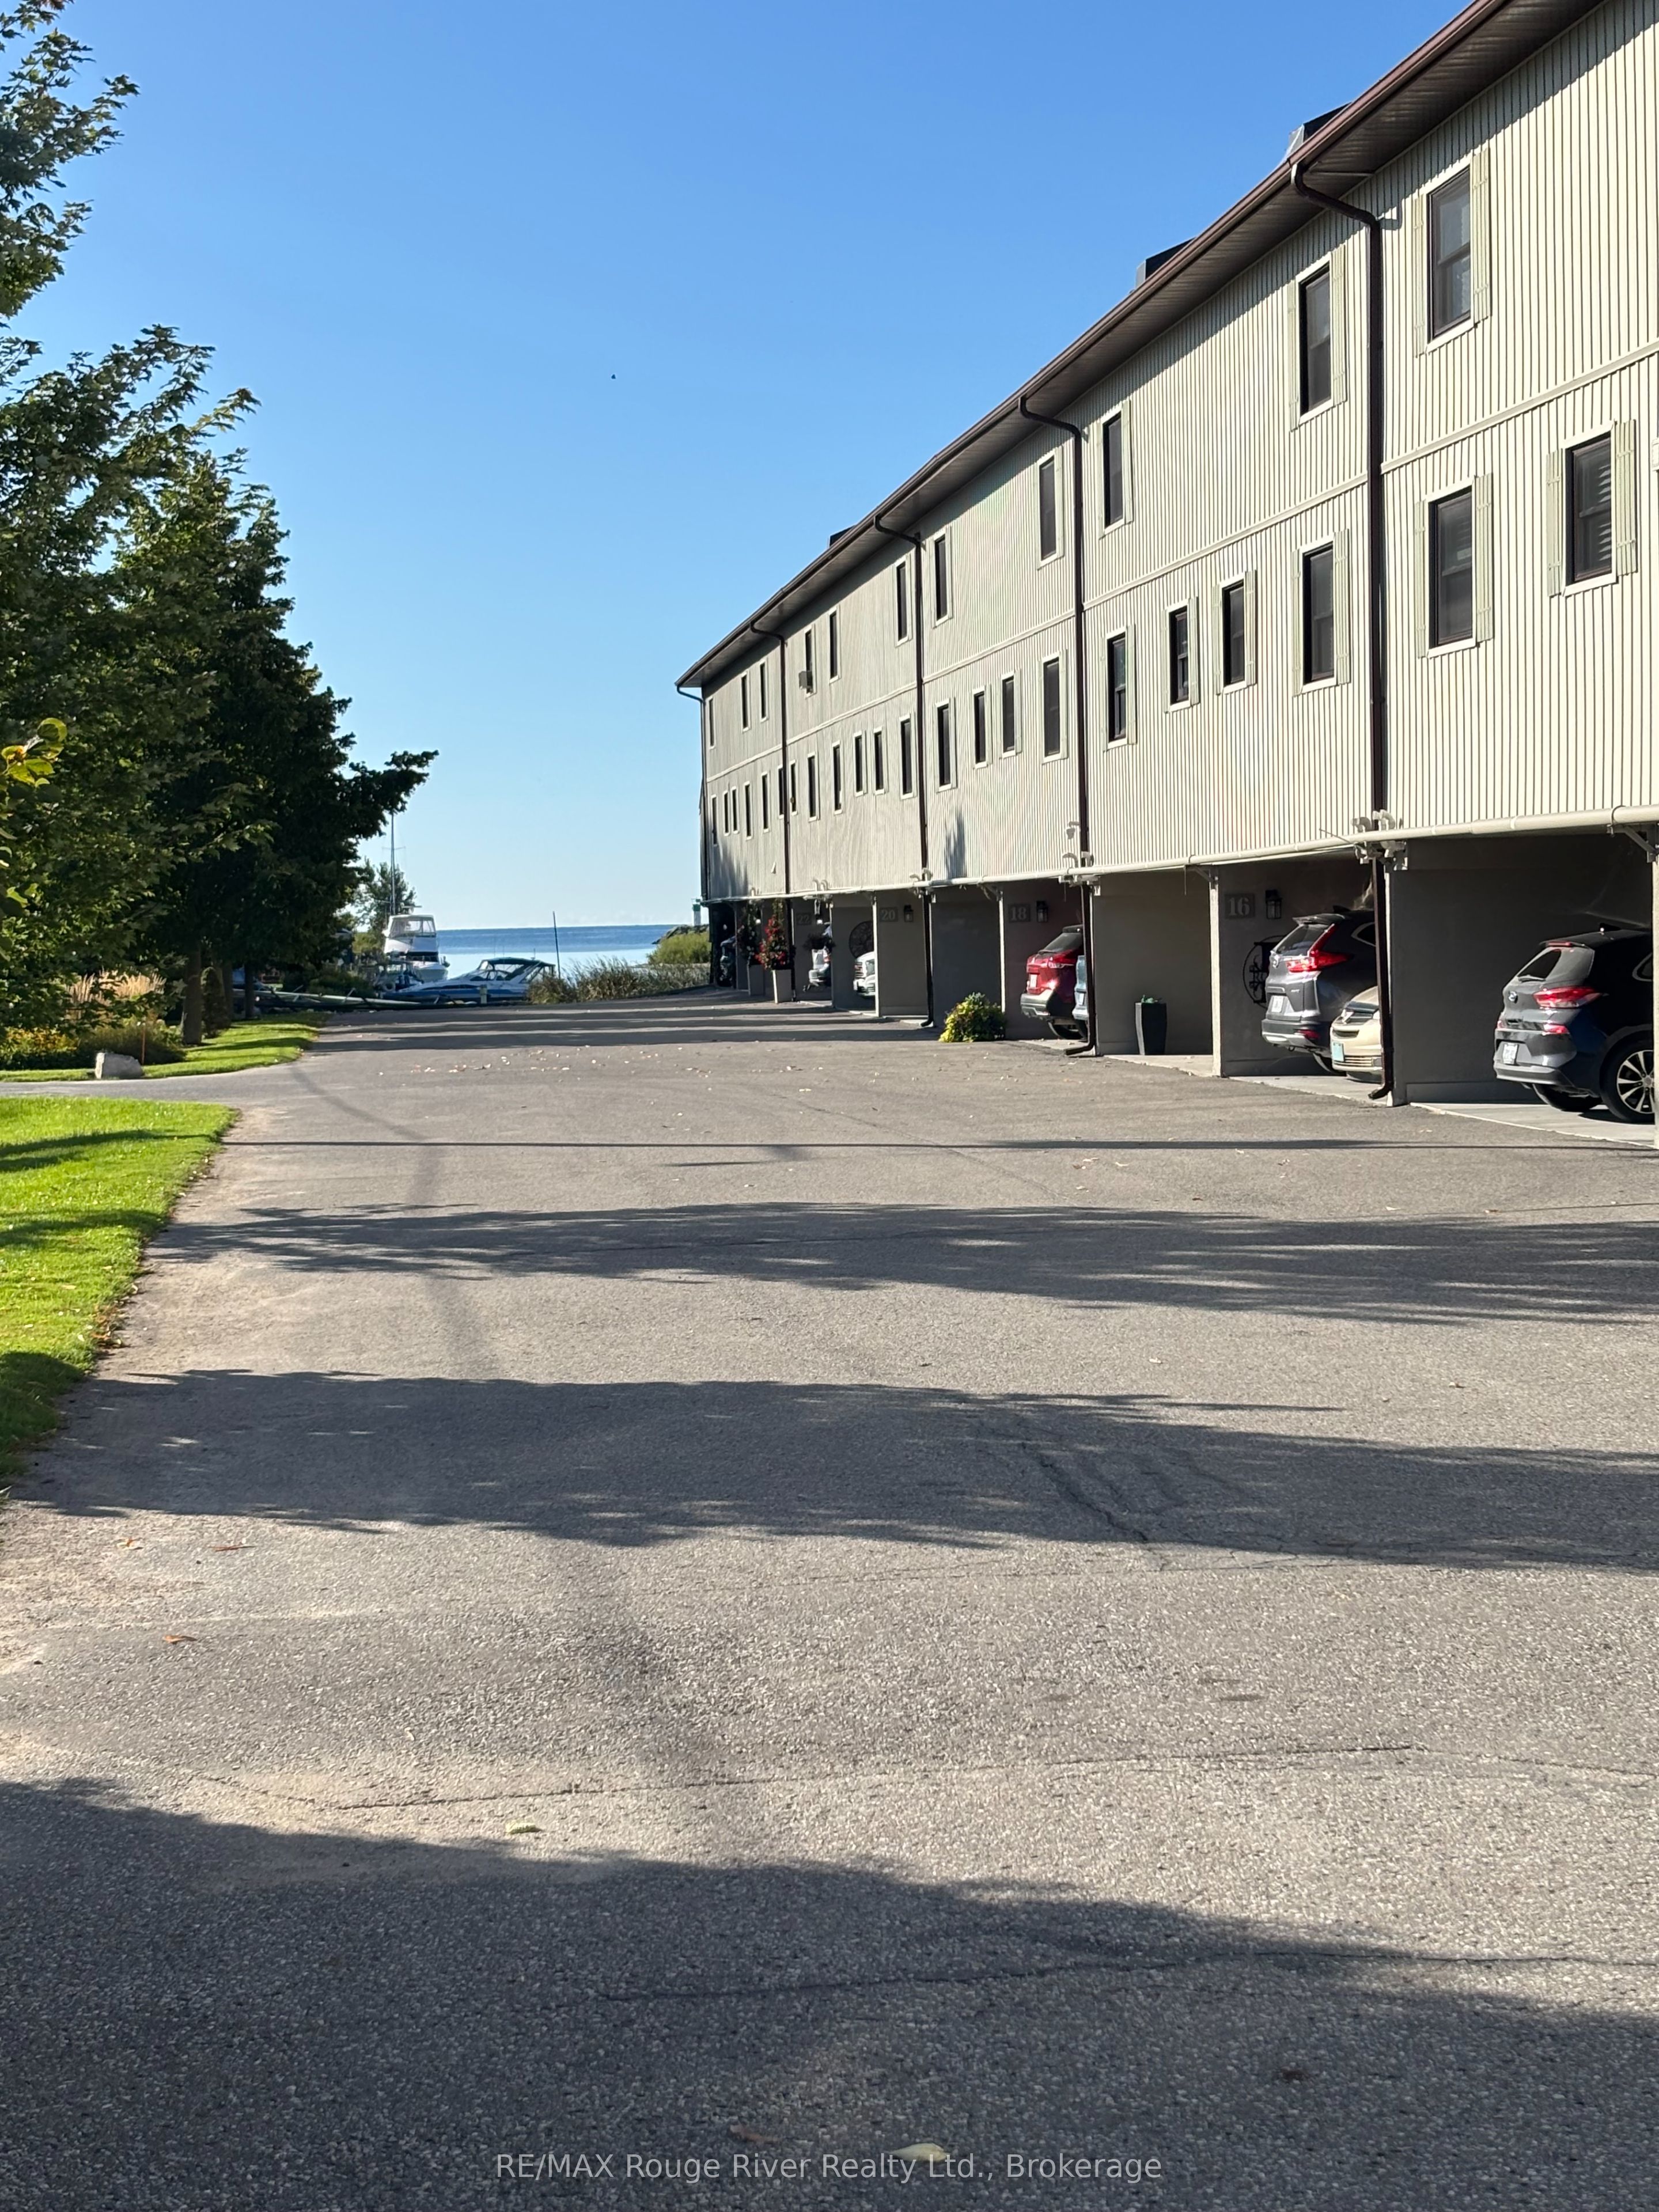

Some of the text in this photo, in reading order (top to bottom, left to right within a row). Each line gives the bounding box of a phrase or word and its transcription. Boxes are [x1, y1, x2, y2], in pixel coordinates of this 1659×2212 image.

[1228, 897, 1250, 916] 16
[797, 914, 810, 924] 22
[881, 909, 895, 921] 20
[1011, 906, 1027, 921] 18
